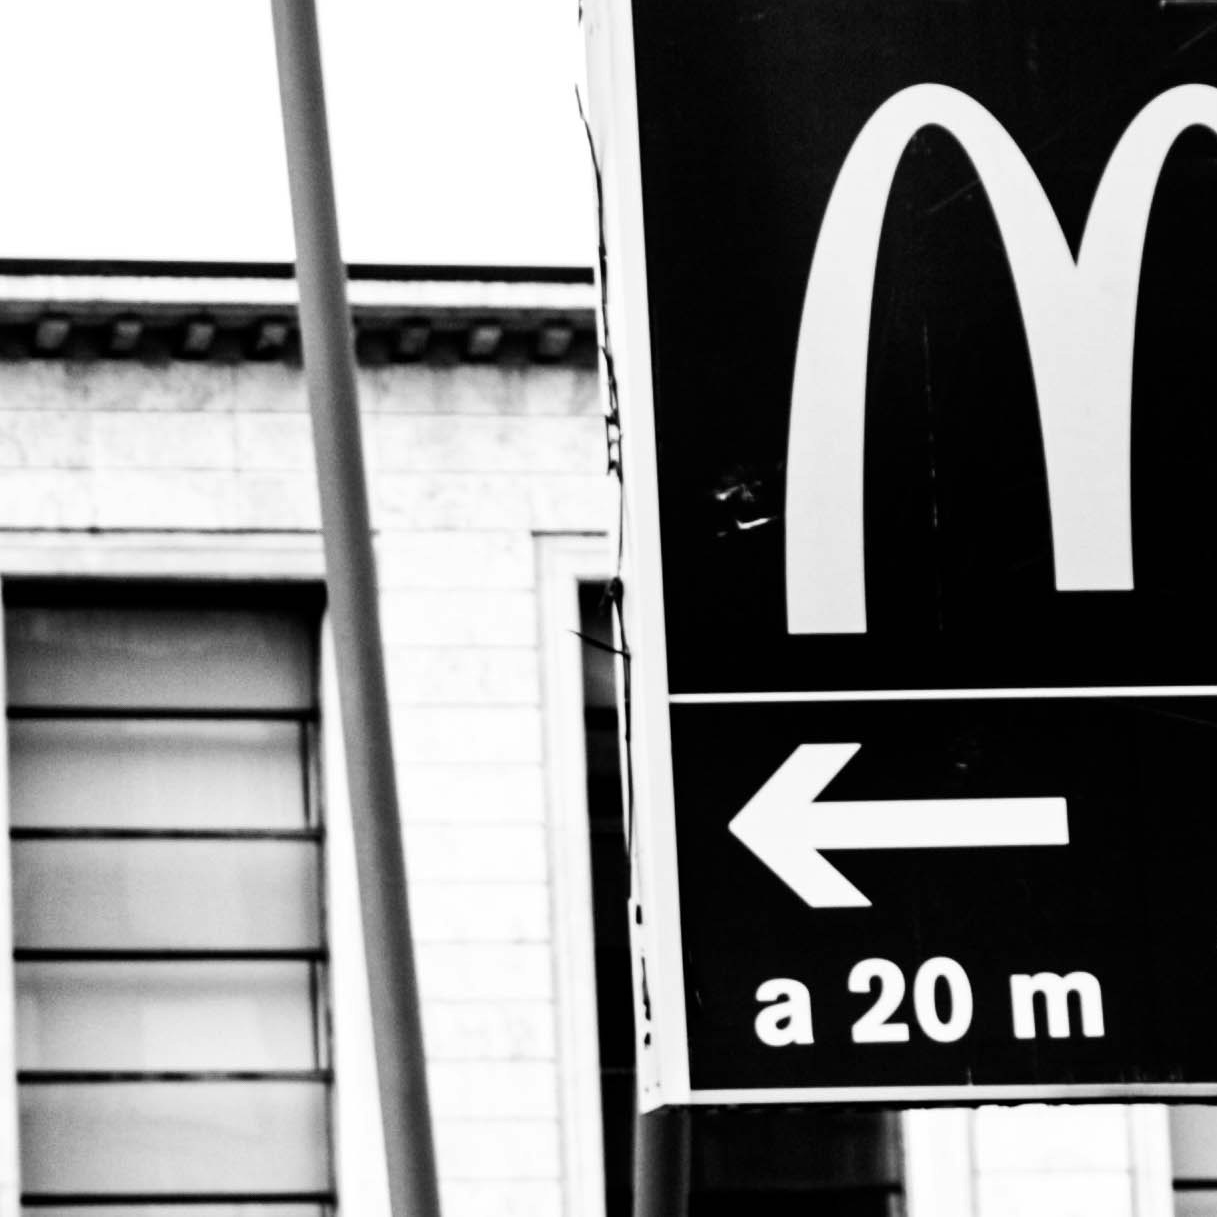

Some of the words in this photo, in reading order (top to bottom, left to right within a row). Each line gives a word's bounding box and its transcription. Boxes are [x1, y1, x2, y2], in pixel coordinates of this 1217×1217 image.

[753, 978, 816, 1048] a
[846, 956, 974, 1045] 20
[1008, 970, 1106, 1041] m
